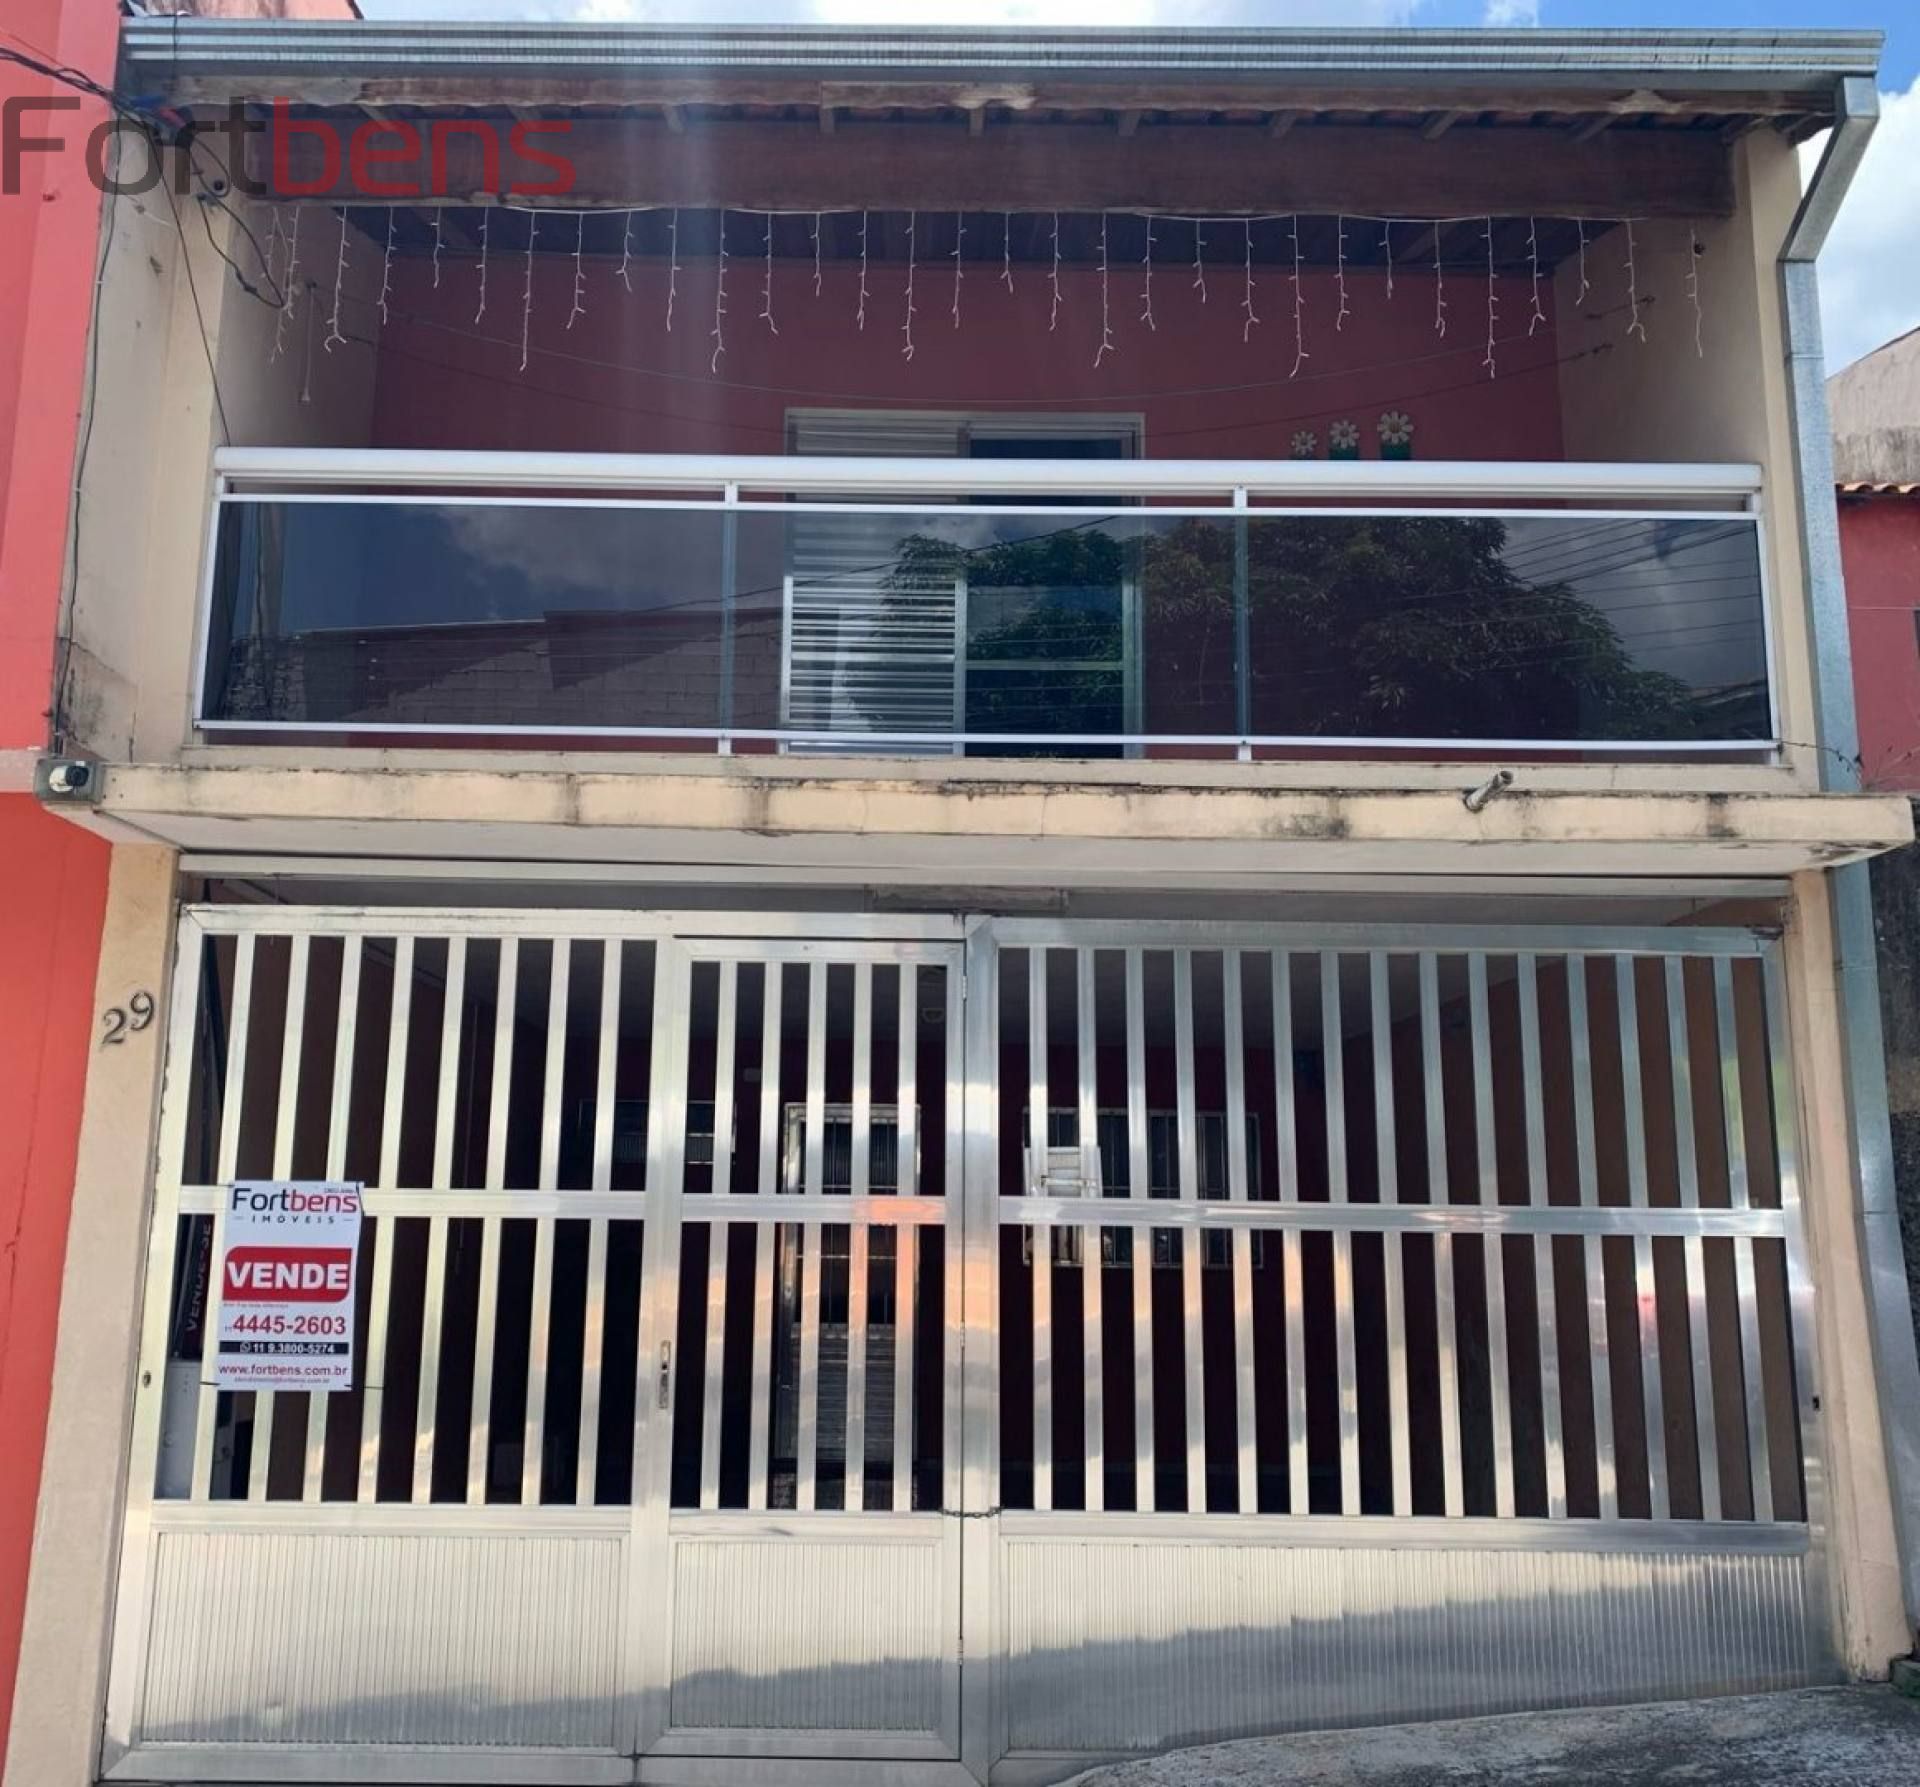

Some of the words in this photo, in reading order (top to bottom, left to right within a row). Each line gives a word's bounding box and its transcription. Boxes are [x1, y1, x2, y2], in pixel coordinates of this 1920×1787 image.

[102, 992, 154, 1045] 29
[231, 1187, 358, 1214] Fortbens
[226, 1261, 349, 1290] VENDE
[233, 1314, 346, 1335] 4445-2603
[254, 1343, 264, 1353] 11
[218, 1363, 347, 1376] www.fortbens.com.br
